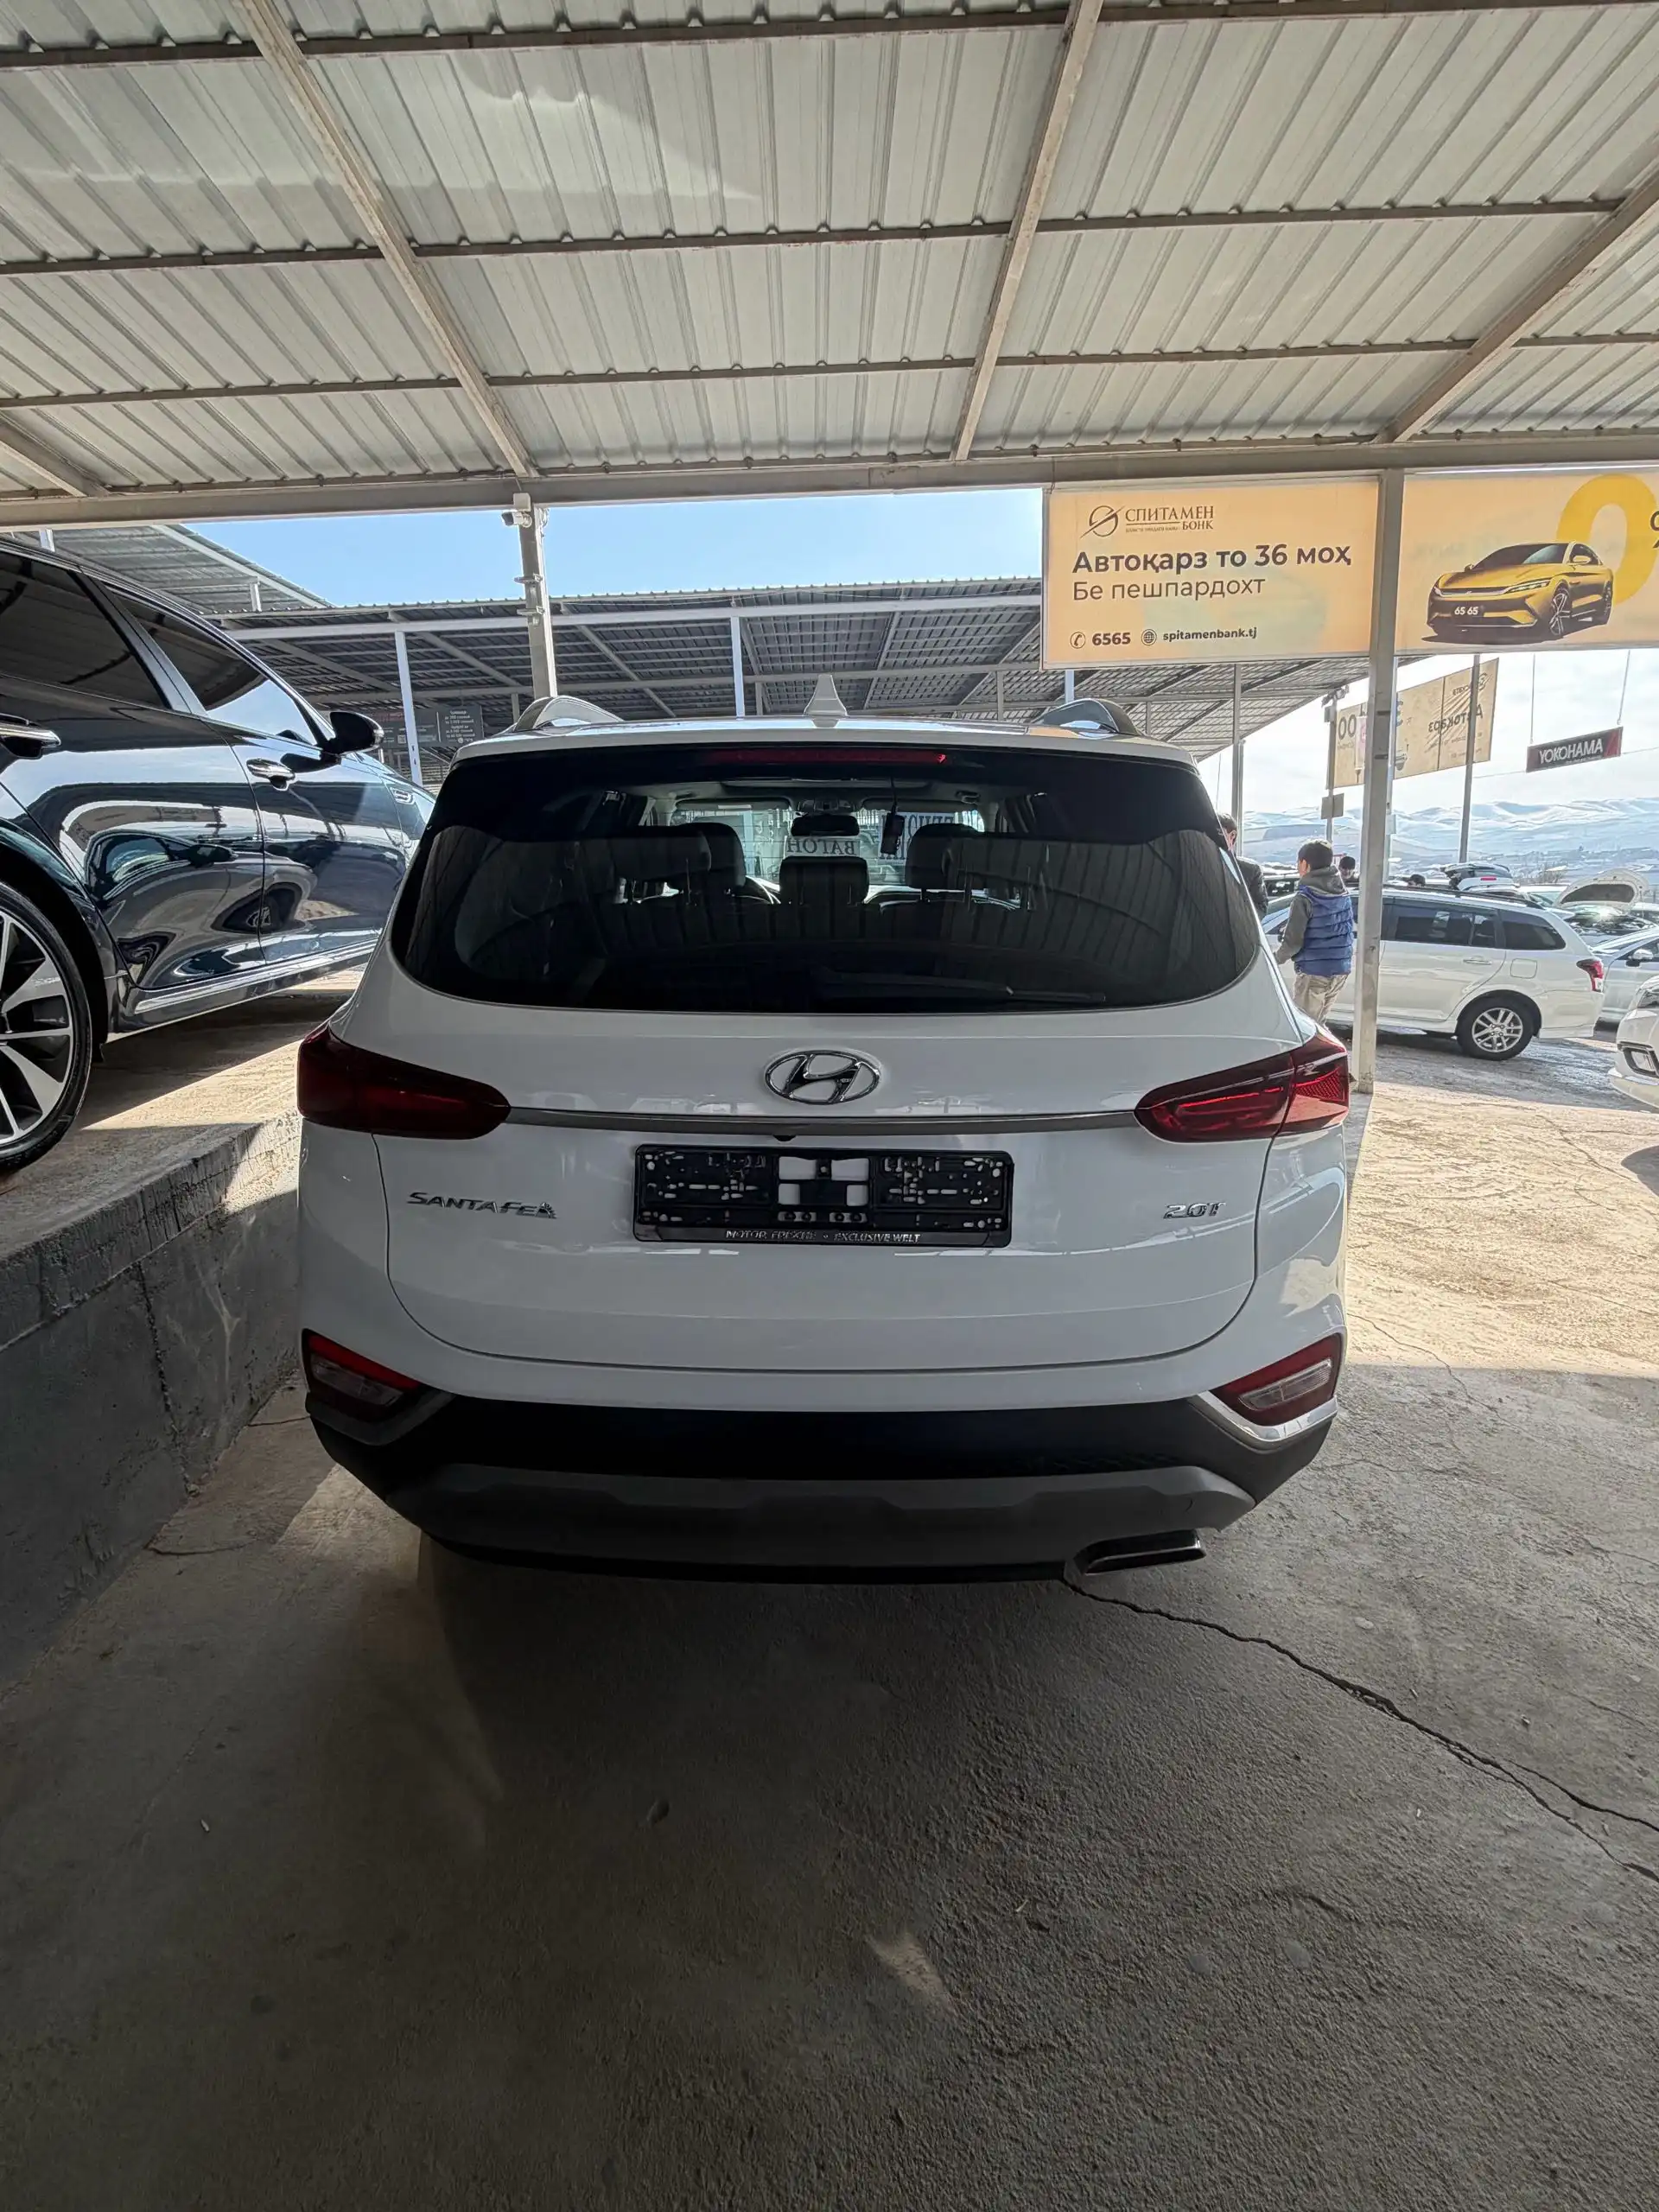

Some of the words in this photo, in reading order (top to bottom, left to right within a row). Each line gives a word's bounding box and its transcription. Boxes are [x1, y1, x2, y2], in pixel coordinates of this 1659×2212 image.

[1126, 505, 1214, 523] СПИТАМЕН
[1182, 518, 1214, 531] БОНК
[1072, 548, 1208, 575] Автоқарз
[1217, 548, 1247, 568] то
[1254, 543, 1287, 567] 36
[1073, 581, 1103, 601] Бе
[1111, 576, 1266, 601] пешпардохт
[1454, 607, 1465, 616] 65
[1466, 607, 1478, 616] 65
[1092, 632, 1131, 645] 6565
[1162, 626, 1258, 643] spitamenbank.tj
[1539, 738, 1604, 764] YOKOHAMA
[834, 1231, 890, 1242] EXCLUSIVE
[892, 1233, 921, 1243] WELT
